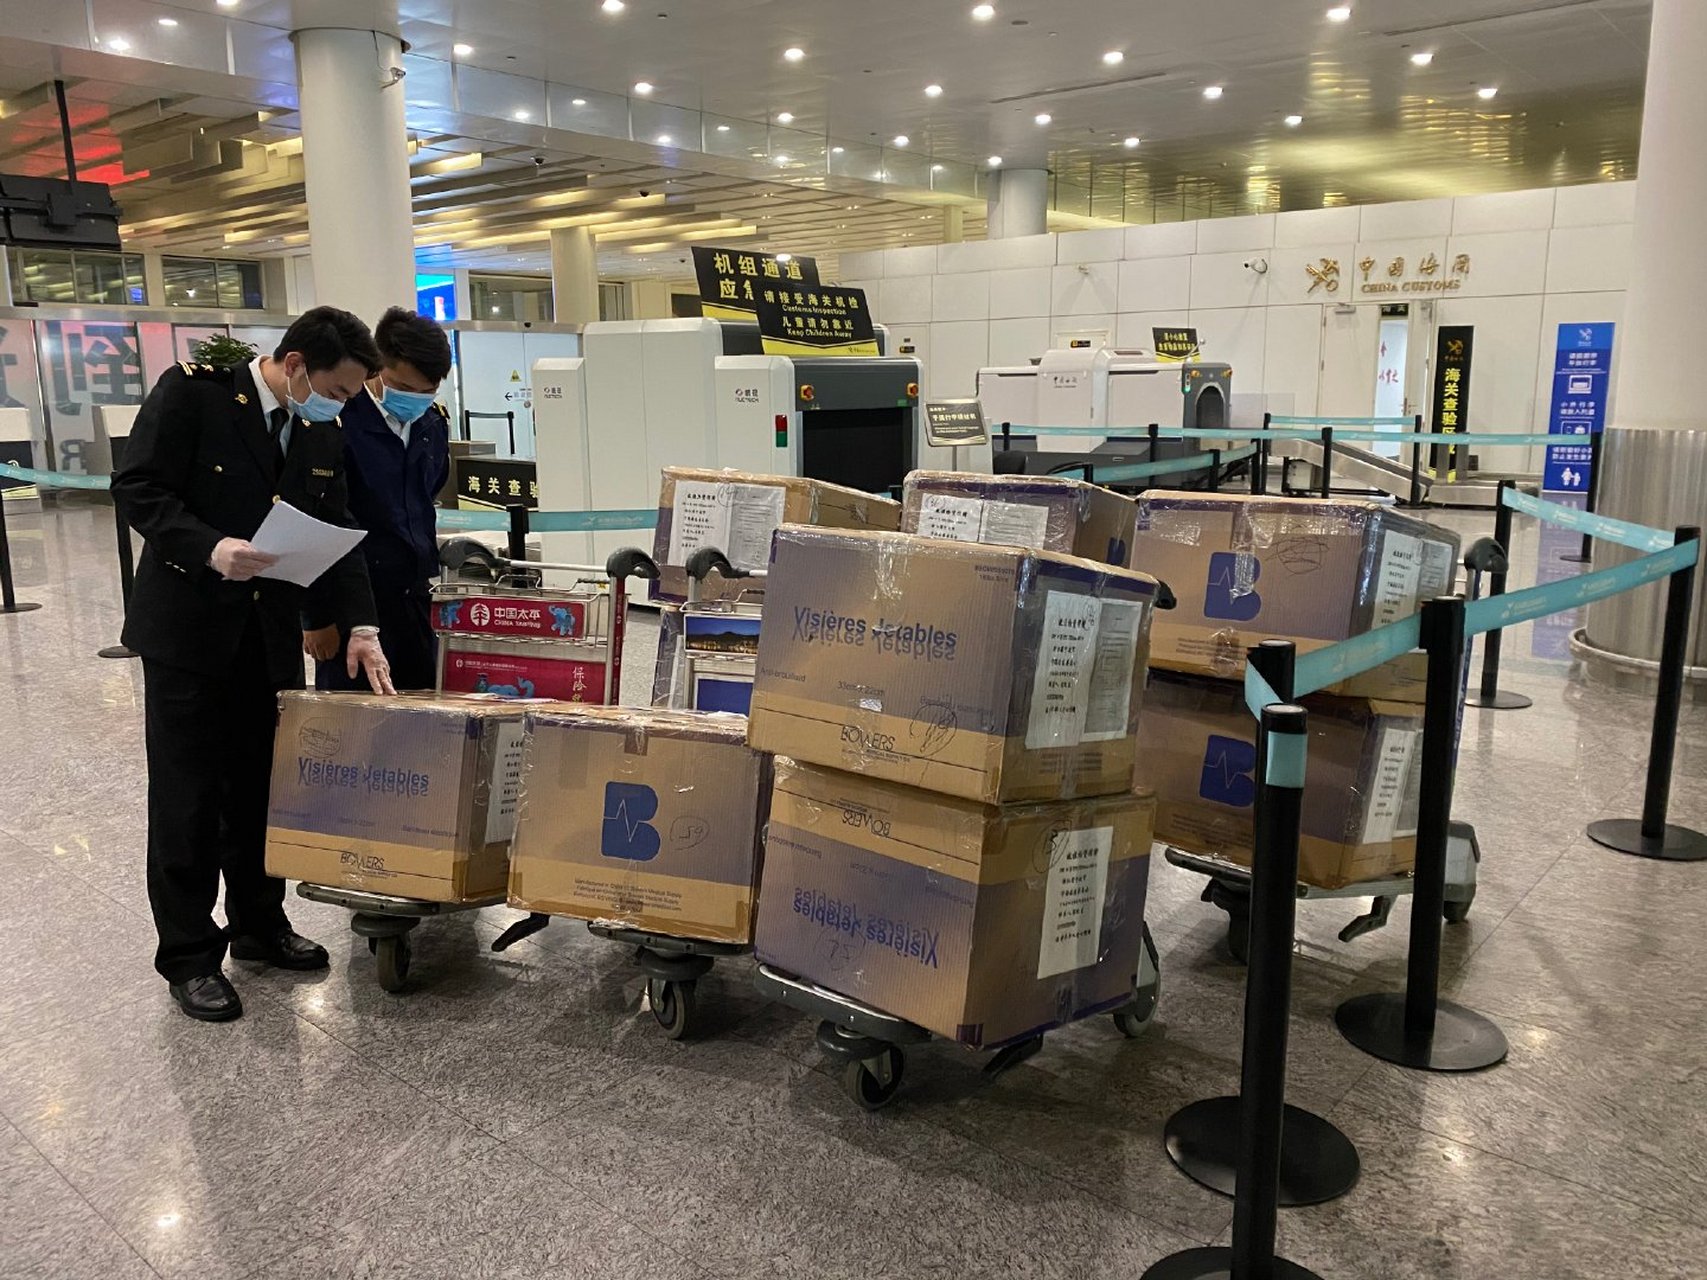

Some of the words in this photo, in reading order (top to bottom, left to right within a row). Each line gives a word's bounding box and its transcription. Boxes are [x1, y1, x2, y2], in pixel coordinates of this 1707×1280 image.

[713, 252, 803, 280] 机组通道
[1361, 283, 1398, 294] CHINA
[1401, 280, 1461, 293] CUSTOMS
[782, 304, 812, 315] Customs
[812, 305, 847, 316] Inspection
[786, 327, 805, 338] Keep
[805, 328, 834, 338] Children
[834, 329, 852, 339] Away
[494, 606, 541, 621] 中国太平
[794, 605, 867, 635] Visières
[872, 618, 957, 650] Jetables
[840, 724, 896, 751] BOWERS
[298, 756, 358, 781] Visières
[363, 765, 429, 787] Jetables
[841, 809, 892, 837] BOWERS
[793, 899, 861, 938] Jetables
[866, 925, 938, 969] Visières
